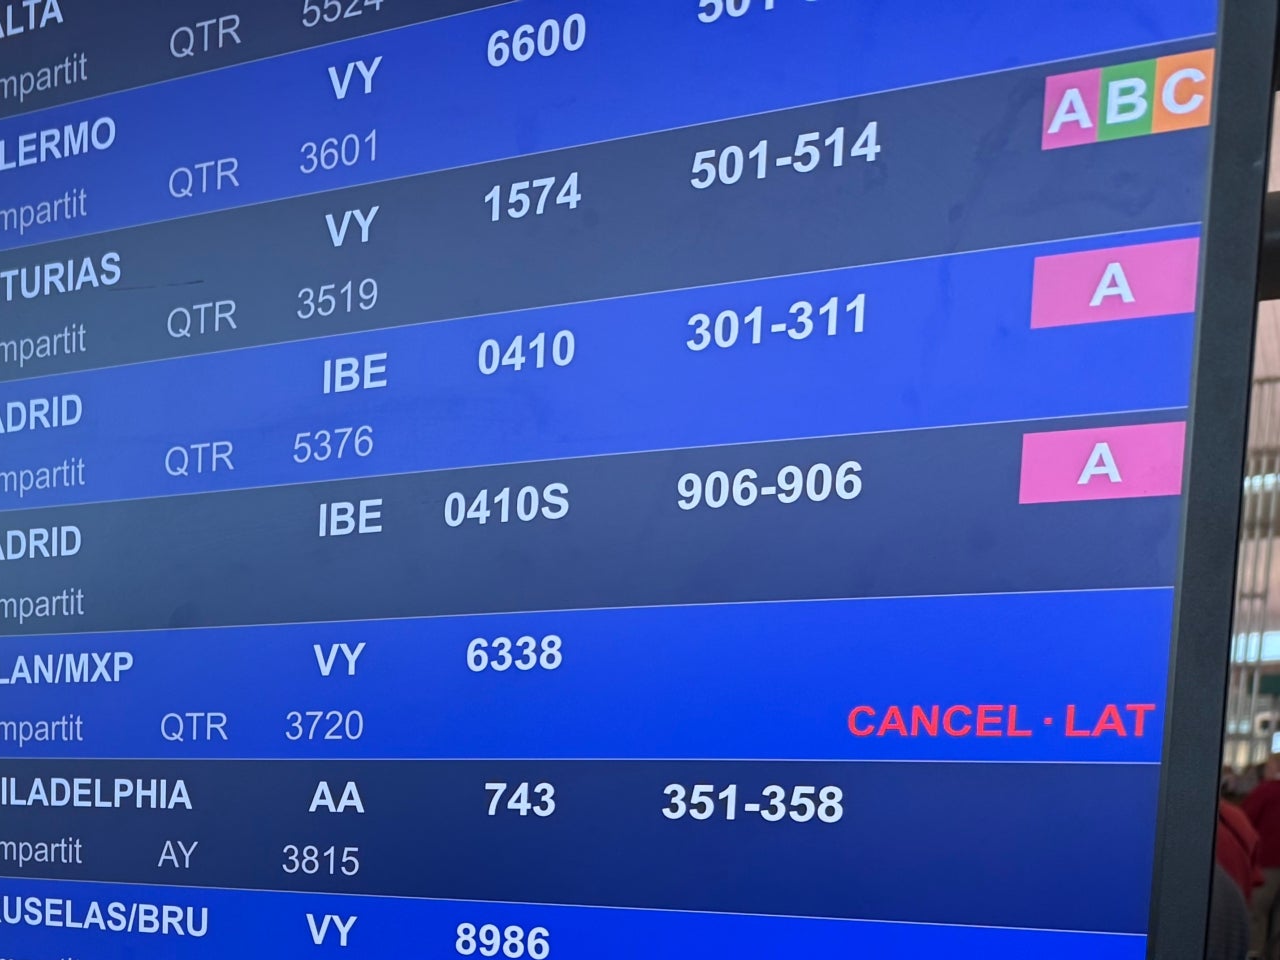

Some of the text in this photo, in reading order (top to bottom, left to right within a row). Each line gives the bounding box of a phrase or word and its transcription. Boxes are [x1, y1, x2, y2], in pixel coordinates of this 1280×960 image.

[170, 14, 241, 58] QTR
[327, 55, 383, 100] VY
[487, 13, 586, 67] 6600
[168, 157, 240, 198] QTR
[300, 128, 376, 174] 3601
[325, 205, 380, 248] VY
[484, 171, 582, 222] 1574
[690, 120, 882, 189] 501-514
[167, 299, 237, 338] QTR
[296, 278, 378, 319] 3519
[323, 352, 388, 394] IBE
[478, 329, 575, 375] 0410
[686, 293, 866, 352] 301-311
[1088, 262, 1136, 307] A
[164, 441, 234, 476] QTR
[293, 425, 374, 464] 5376
[318, 498, 383, 537] IBE
[444, 482, 570, 527] 0410S
[677, 460, 863, 511] 906-906
[1076, 441, 1123, 485] A
[313, 642, 367, 676] VY
[466, 634, 563, 672] 6338
[160, 712, 228, 742] QTR
[285, 710, 364, 740] 3720
[308, 780, 365, 813] AA
[484, 782, 556, 817] 743
[661, 783, 844, 824] 351-358
[157, 840, 199, 869] AY
[282, 844, 360, 876] 3815
[306, 913, 358, 947] VY
[455, 922, 550, 960] 8986
